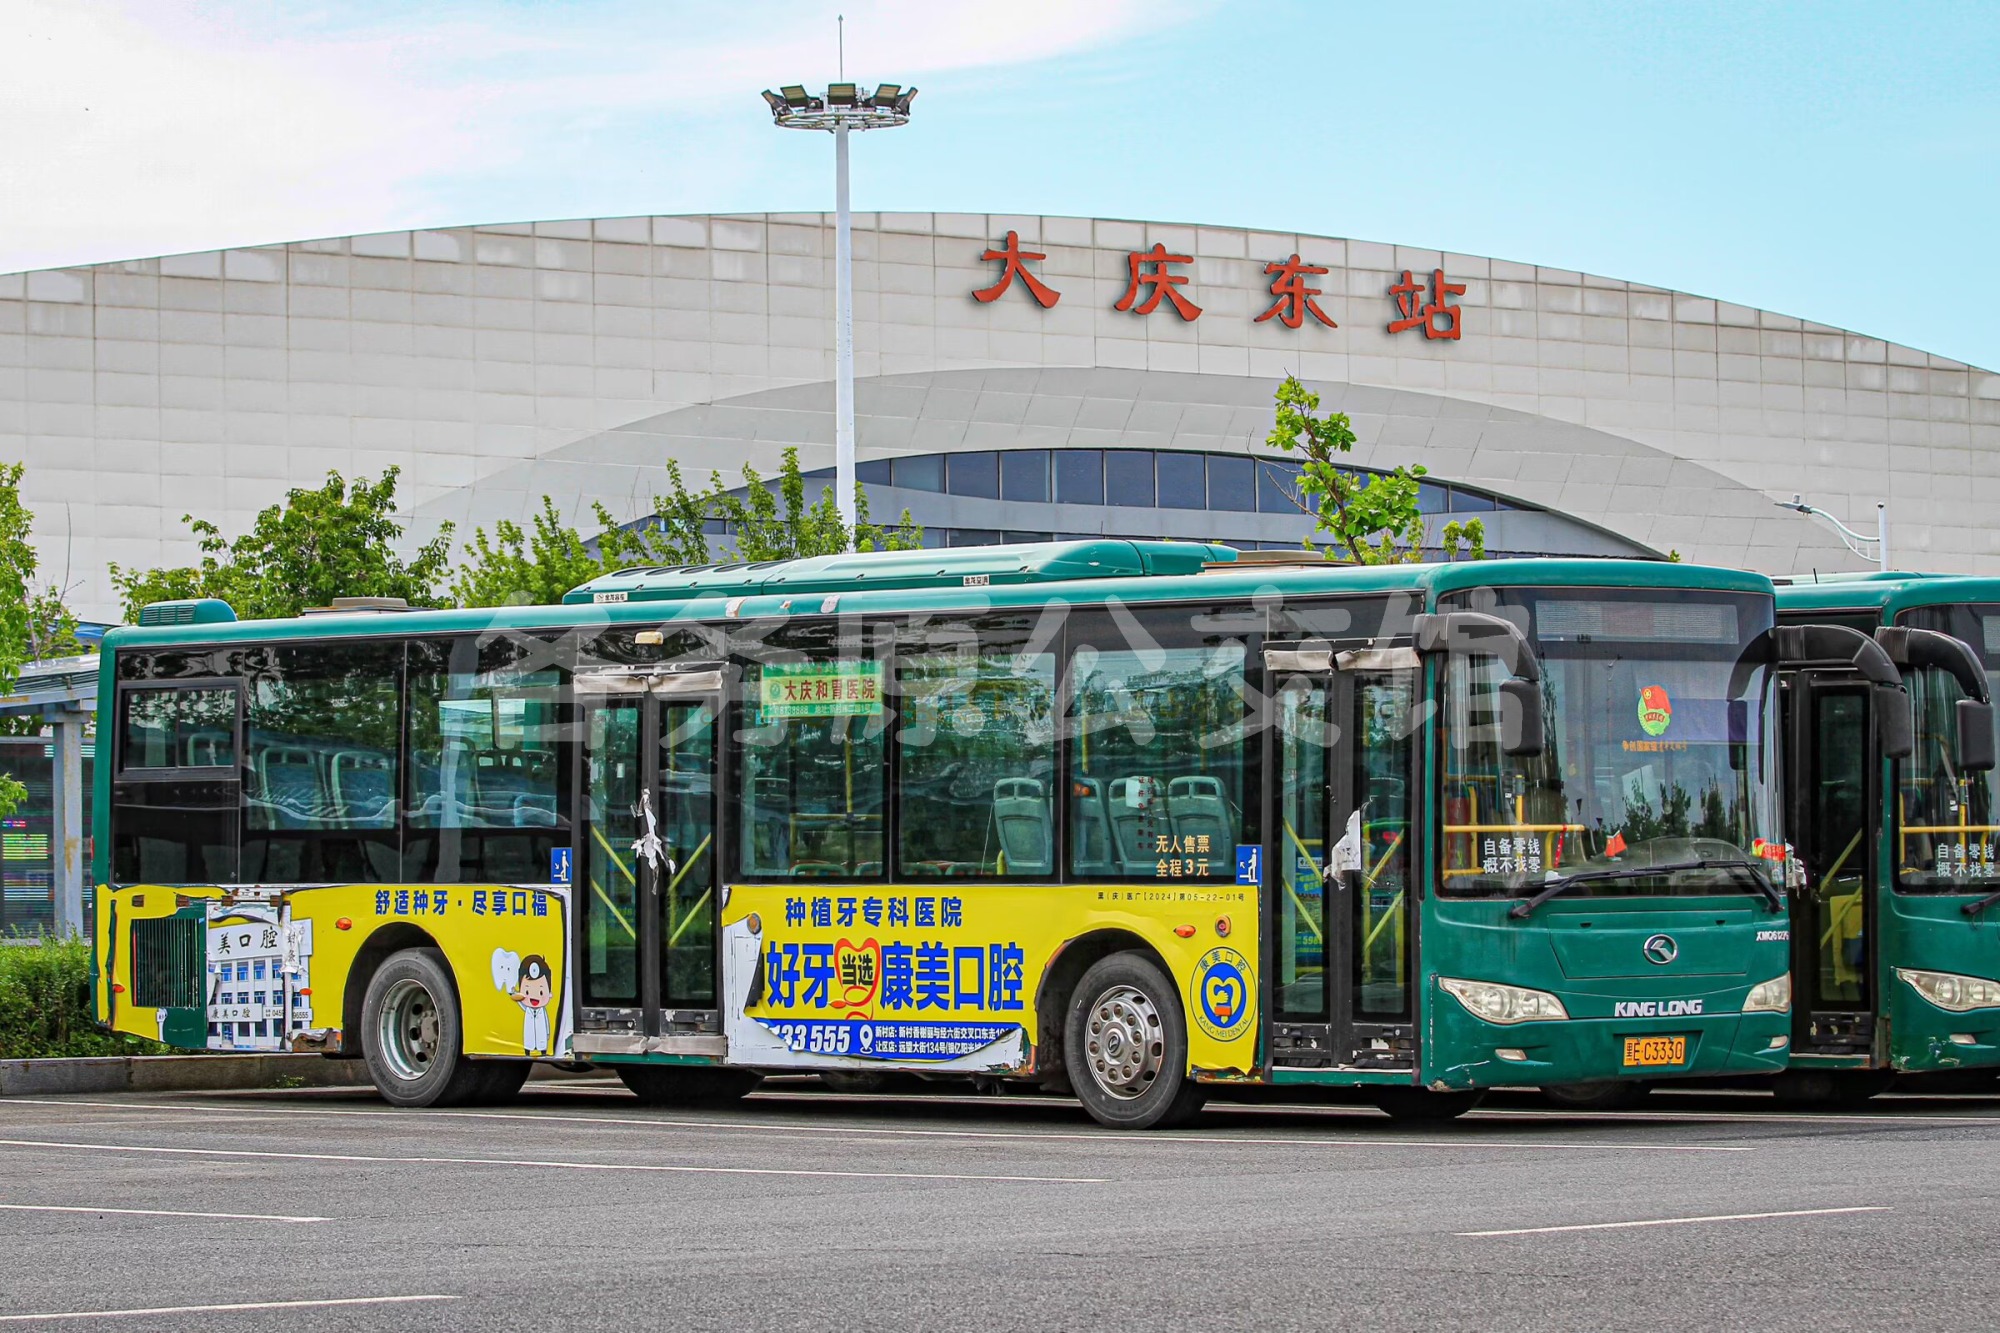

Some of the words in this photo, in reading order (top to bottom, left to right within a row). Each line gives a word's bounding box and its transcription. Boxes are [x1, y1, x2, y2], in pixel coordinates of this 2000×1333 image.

[971, 230, 1467, 340] 大庆东站
[1155, 835, 1210, 853] 无人售票
[1484, 838, 1540, 855] 自备零钱
[1937, 843, 1994, 859] 自备零钱
[1155, 858, 1210, 877] 全程3元
[1483, 856, 1540, 873] 概不找零
[1936, 862, 1995, 877] 概不找零
[785, 896, 962, 927] 种植牙专科医院
[1200, 950, 1247, 974] 康美口腔
[766, 941, 835, 1008] 好牙
[842, 954, 874, 987] 当选
[880, 941, 1024, 1010] 康美口腔
[210, 1007, 251, 1019] 康美口腔
[1614, 1001, 1656, 1017] KING
[1658, 999, 1703, 1016] LONG
[1198, 1015, 1214, 1034] KANG
[1215, 1029, 1228, 1038] MEI
[1228, 1019, 1249, 1038] DENTAL
